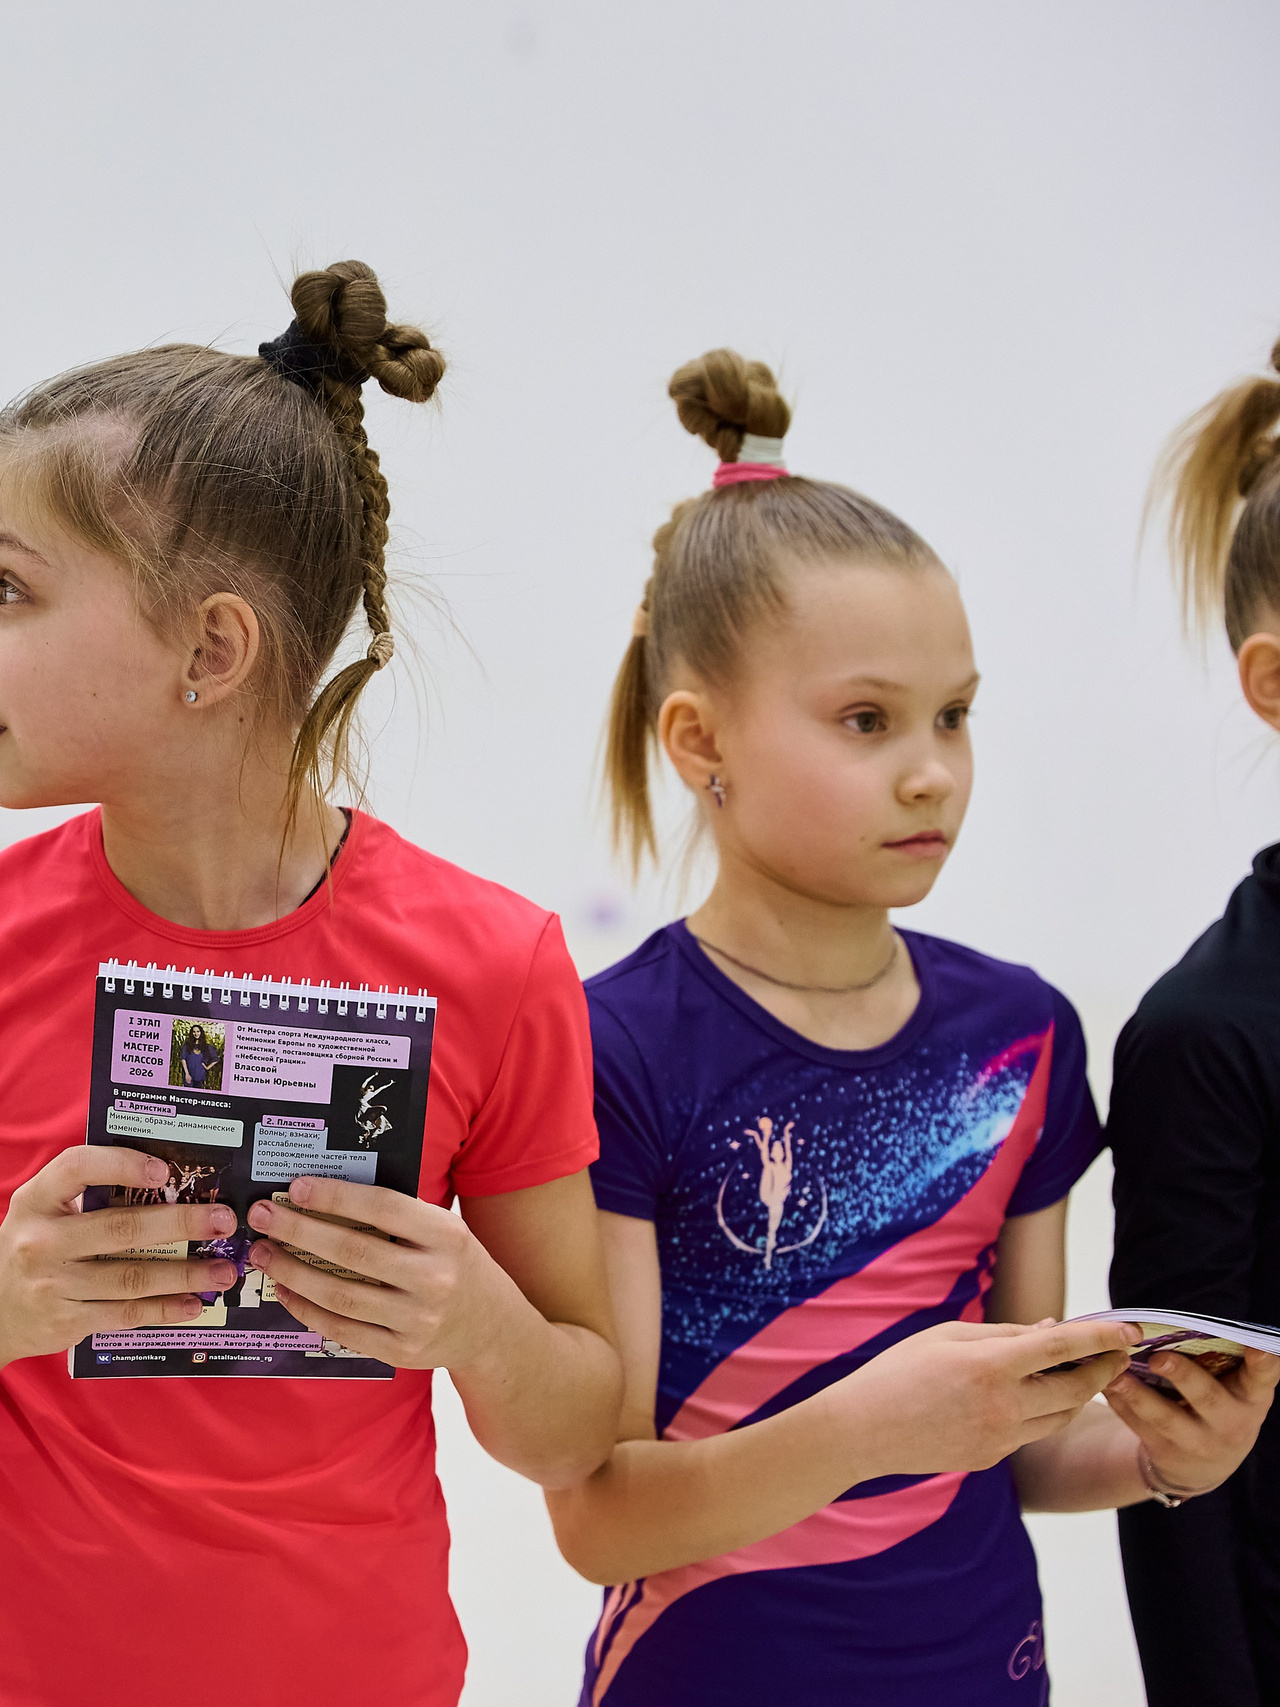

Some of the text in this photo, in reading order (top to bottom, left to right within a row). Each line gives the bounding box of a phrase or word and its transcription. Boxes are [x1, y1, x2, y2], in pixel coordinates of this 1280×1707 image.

[136, 1017, 161, 1028] ЭТАП
[128, 1029, 160, 1040] СЕРИИ
[247, 1026, 276, 1036] Мастера
[277, 1030, 301, 1038] спорта
[303, 1032, 364, 1043] Международного
[365, 1038, 391, 1046] класса,
[123, 1041, 163, 1053] МАСТЕР-
[236, 1034, 276, 1044] Чемпионки
[278, 1039, 305, 1047] Европы
[317, 1043, 376, 1053] художественной
[235, 1044, 278, 1055] гимнастике,
[282, 1049, 333, 1059] постановщика
[335, 1053, 365, 1061] сборной
[367, 1055, 391, 1063] России
[235, 1053, 306, 1065] «Небесной Грации»
[121, 1054, 164, 1066] КЛАССОВ
[129, 1067, 154, 1078] 2026
[234, 1062, 277, 1074] Власовой
[233, 1074, 317, 1089] Натальи Юрьевны
[113, 1088, 232, 1109] В программе Мастер-класса:
[129, 1102, 172, 1114] Артистика
[109, 1112, 236, 1133] Мимика; образы; динамические
[277, 1119, 316, 1128] Пластика
[108, 1123, 154, 1135] изменения.
[259, 1128, 321, 1140] Волны; взмахи;
[258, 1139, 315, 1150] расслабление;
[257, 1149, 319, 1160] сопровождение
[320, 1152, 348, 1161] частей
[256, 1160, 343, 1171] головой; постепенное
[255, 1170, 299, 1179] включение
[95, 1332, 134, 1340] Вручение
